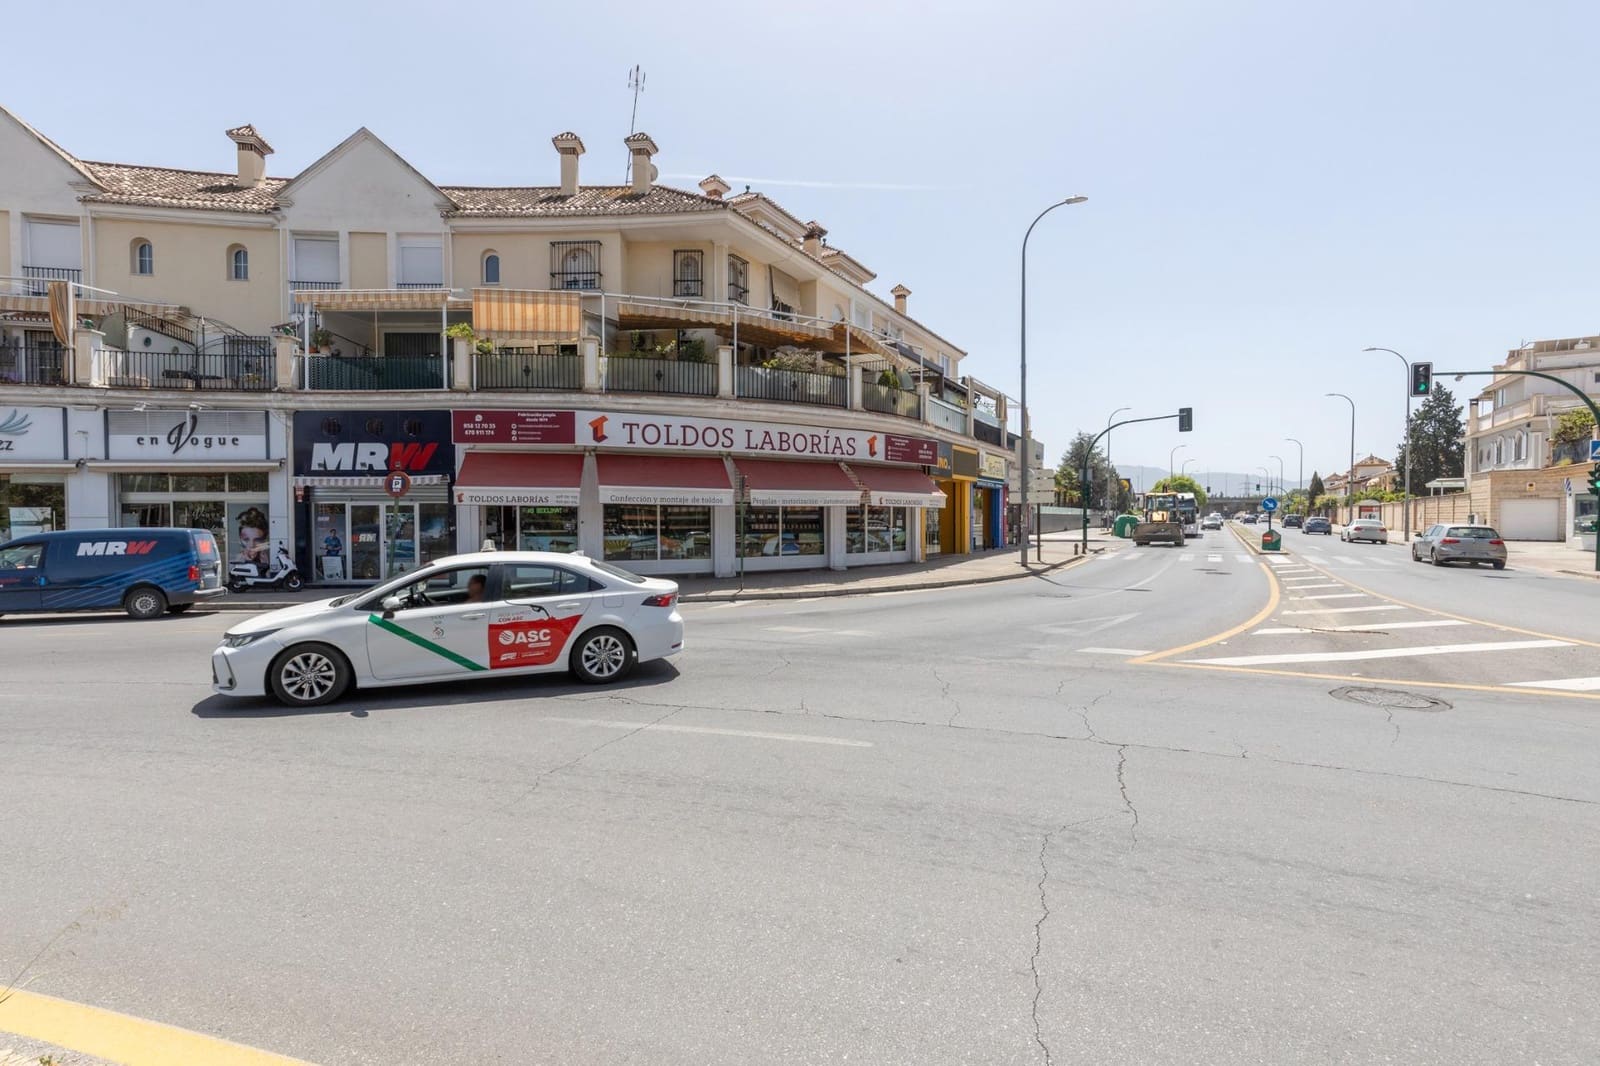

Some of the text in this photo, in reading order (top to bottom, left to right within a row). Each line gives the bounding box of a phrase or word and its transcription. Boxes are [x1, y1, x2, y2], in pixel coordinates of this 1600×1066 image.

[136, 414, 240, 454] en Vogue
[622, 422, 856, 456] TOLDOS LABORÍAS
[310, 442, 438, 471] MRW
[506, 494, 549, 503] LABORÍAS
[660, 496, 688, 504] montaje
[77, 540, 158, 556] MRW
[515, 629, 551, 644] ASC
